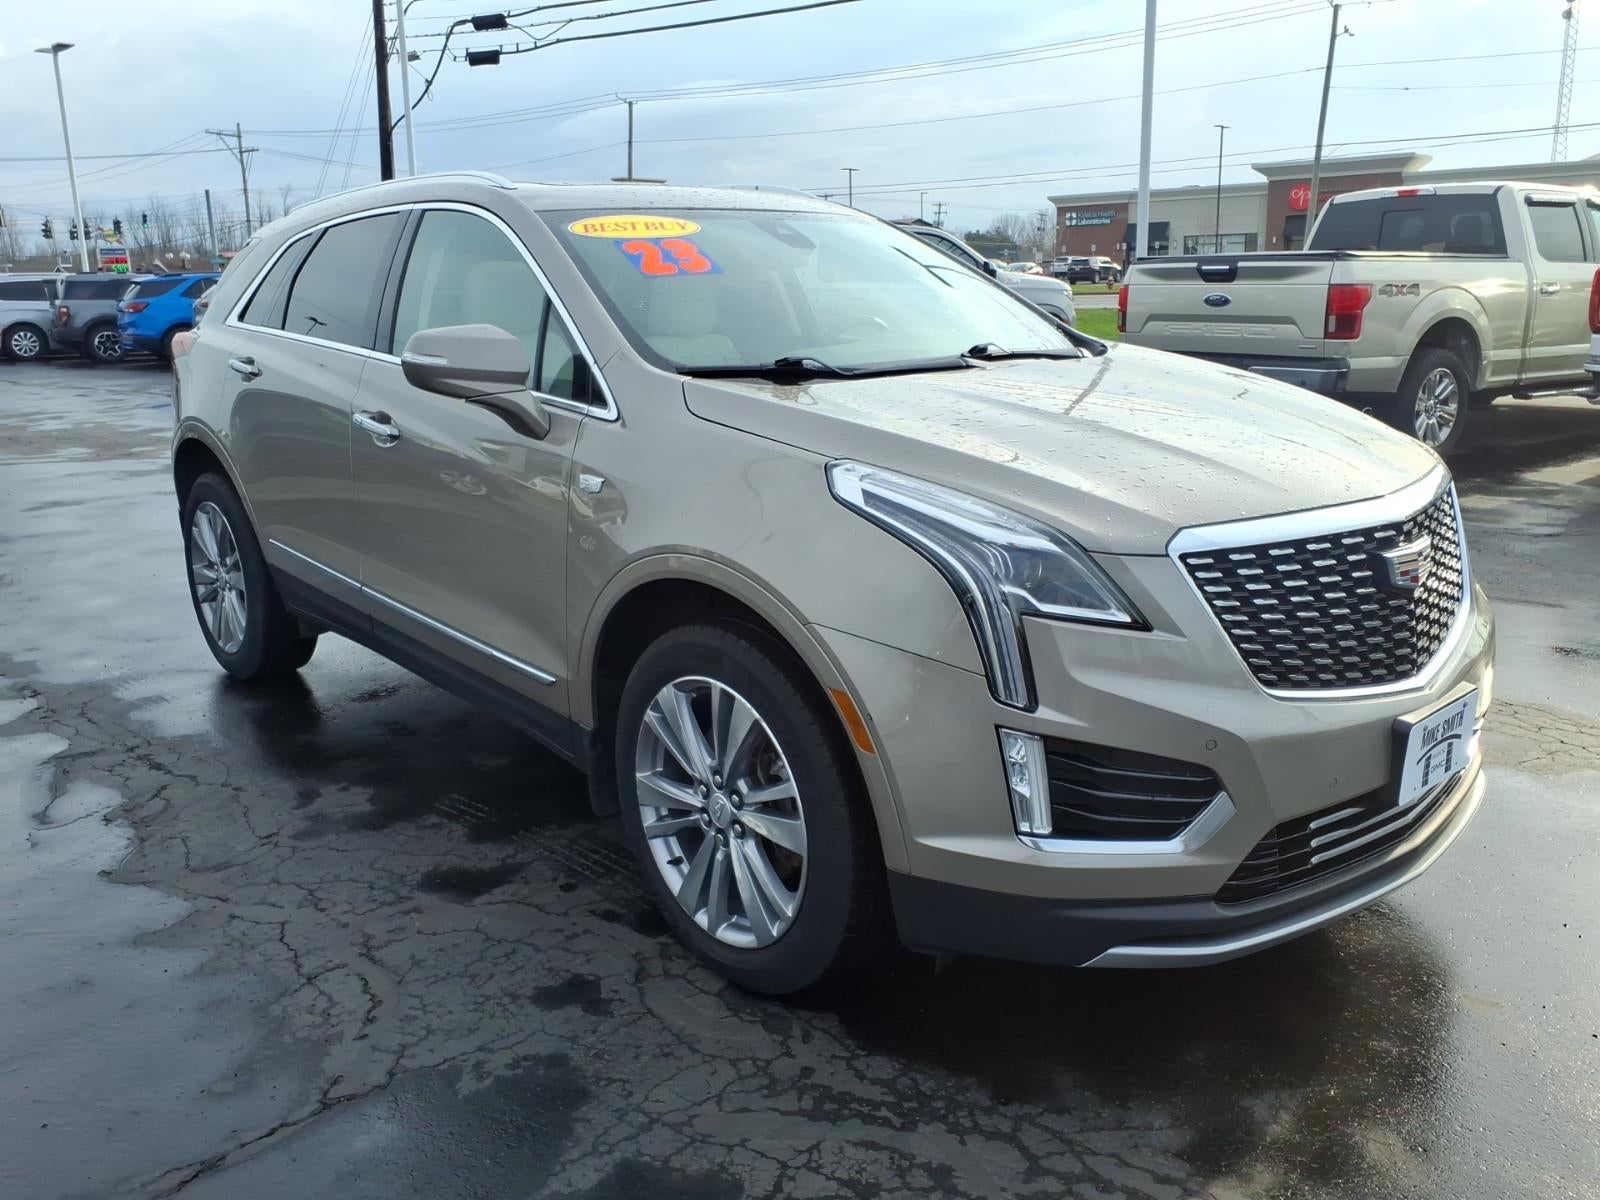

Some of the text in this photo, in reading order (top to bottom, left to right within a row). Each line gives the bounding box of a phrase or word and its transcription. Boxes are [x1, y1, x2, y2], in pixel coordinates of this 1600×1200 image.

[583, 221, 688, 233] BEST BUY
[622, 239, 712, 275] 23
[1420, 710, 1464, 751] MIKE SMITH
